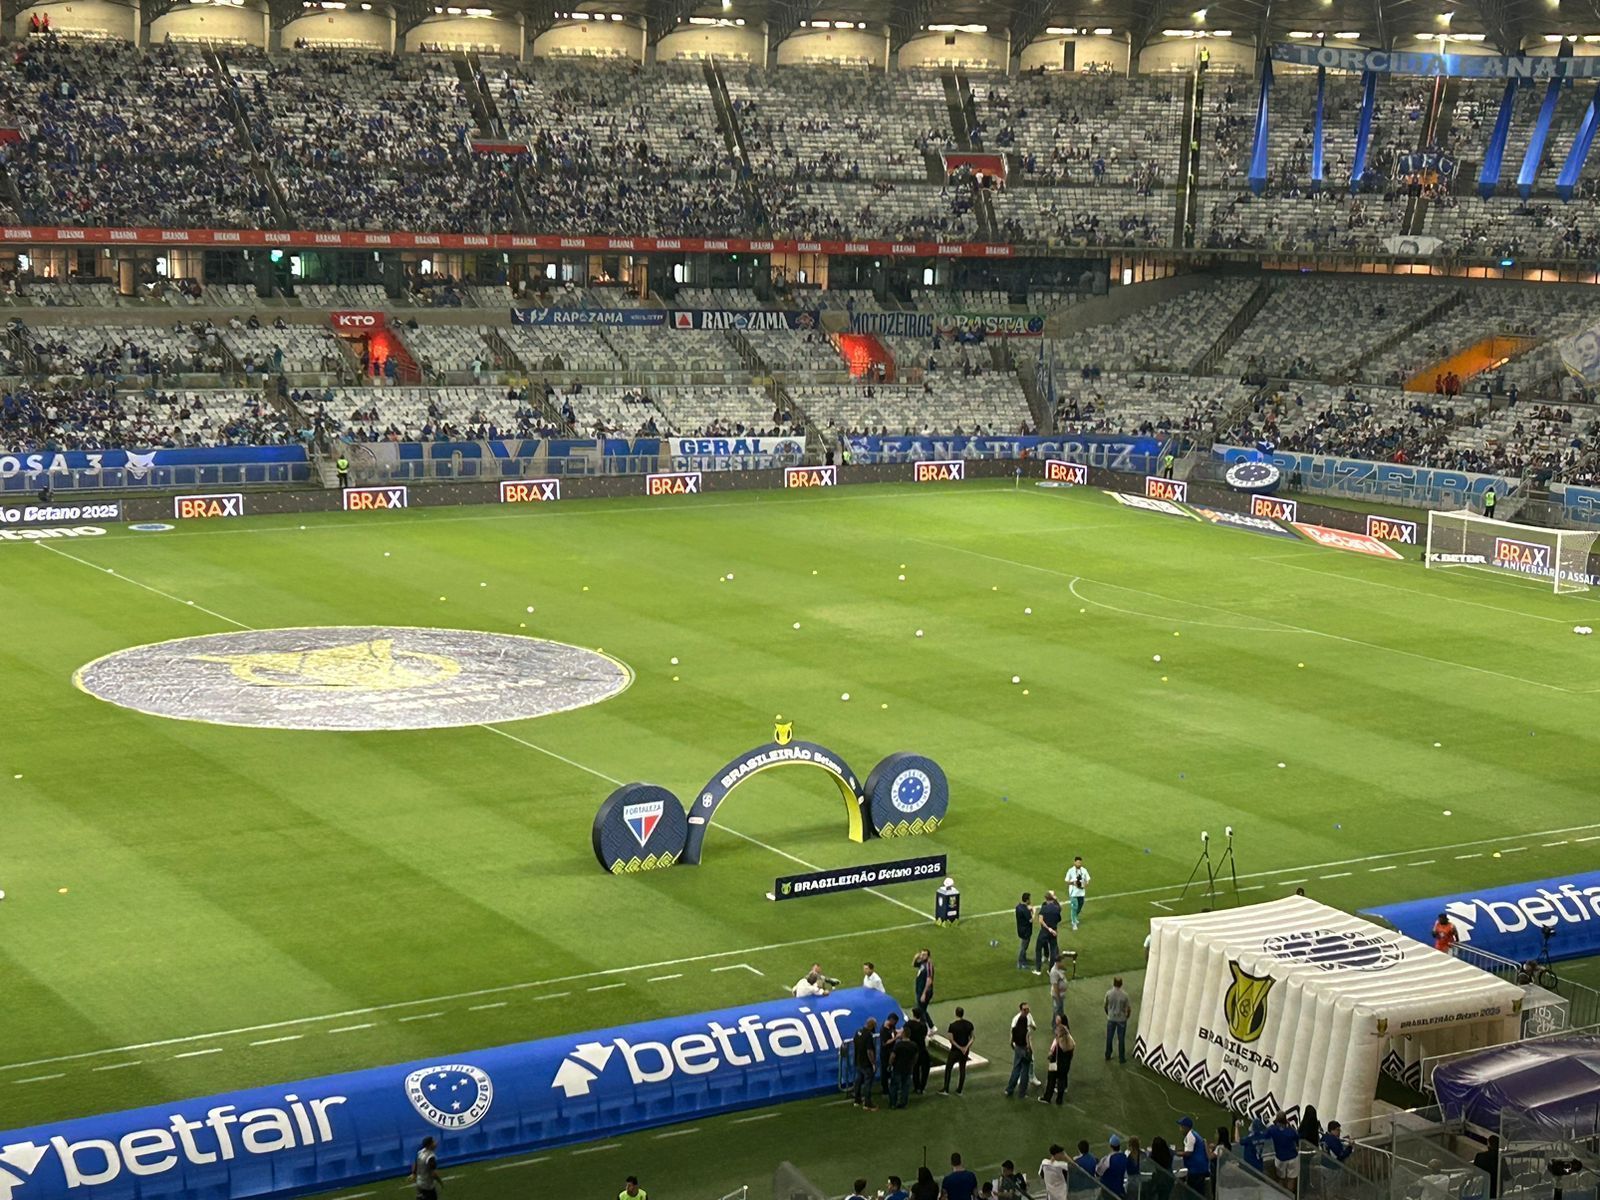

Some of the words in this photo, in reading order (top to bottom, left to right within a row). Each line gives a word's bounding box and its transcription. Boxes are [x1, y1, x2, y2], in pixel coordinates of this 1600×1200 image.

[339, 315, 376, 326] KTO
[679, 439, 768, 455] GERAL
[84, 454, 104, 475] 3
[919, 464, 961, 482] BRAX
[1050, 464, 1084, 485] BRAX
[652, 476, 697, 495] BRAX
[789, 469, 832, 488] BRAX
[350, 488, 402, 510] BRAX
[506, 482, 555, 502] BRAX
[1150, 481, 1184, 502] BRAX
[24, 506, 81, 521] Betano
[82, 504, 119, 518] 2025
[181, 497, 237, 518] BRAX
[1255, 499, 1294, 522] BRAX
[0, 526, 107, 540] tano
[1371, 520, 1413, 545] BRAX
[1500, 542, 1546, 567] BRAX
[721, 746, 812, 789] BRASILEIRÃO
[794, 870, 876, 893] BRASILEIRÃO
[877, 867, 912, 880] Betano
[914, 862, 941, 874] 2025
[613, 1006, 852, 1085] betfair
[50, 1094, 347, 1189] betfair
